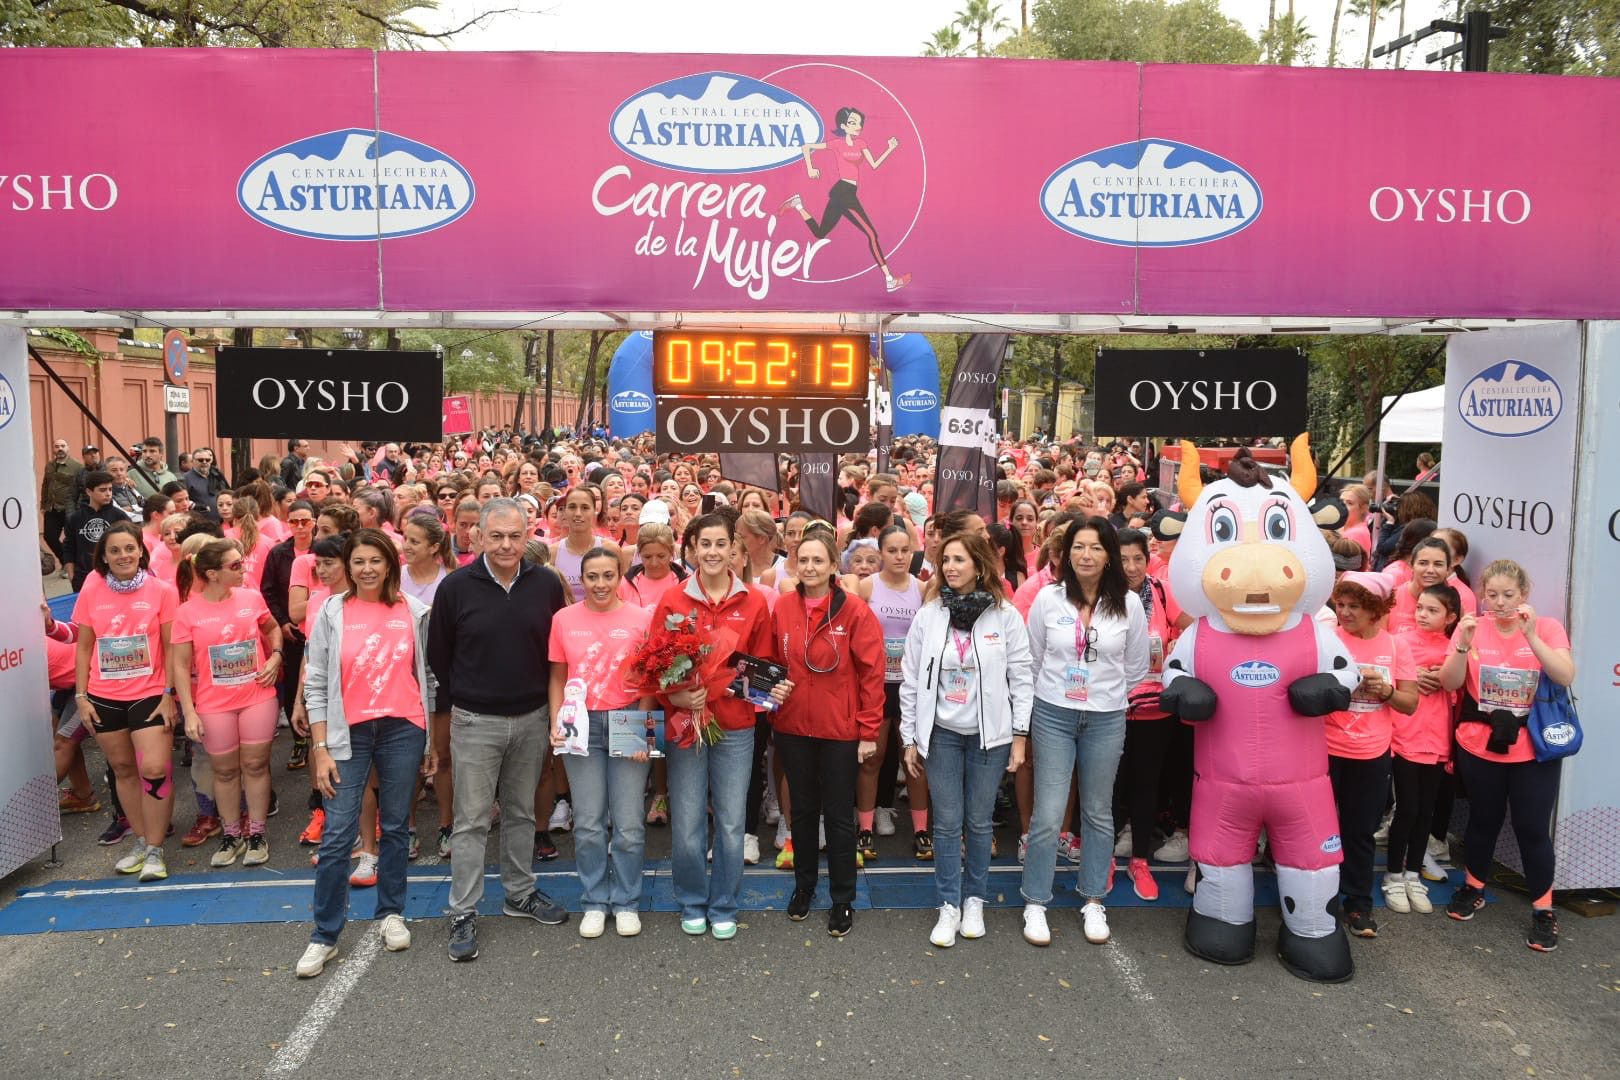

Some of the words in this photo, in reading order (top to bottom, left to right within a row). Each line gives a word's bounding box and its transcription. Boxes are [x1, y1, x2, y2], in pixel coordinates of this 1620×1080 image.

[626, 108, 806, 148] ASTURIANA
[659, 107, 727, 117] CENTRAL
[734, 107, 801, 118] LECHERA
[256, 170, 457, 212] ASTURIANA
[291, 167, 365, 178] CENTRAL
[372, 167, 449, 178] LECHERA
[1092, 176, 1163, 187] CENTRAL
[1169, 177, 1240, 188] LECHERA
[0, 173, 118, 211] SHO
[592, 165, 766, 219] Carrera
[1057, 178, 1246, 219] ASTURIANA
[1369, 186, 1532, 225] OYSHO
[635, 220, 667, 256] de
[675, 216, 698, 257] la
[693, 215, 832, 300] Mujer
[667, 339, 854, 386] 09:52:13
[252, 377, 410, 414] OYSHO
[614, 399, 650, 408] ASTURIANA
[1129, 380, 1278, 412] OYSHO
[1465, 389, 1554, 416] ASTURIANA
[666, 406, 860, 446] OYSHO
[1453, 492, 1554, 536] OYSHO
[880, 606, 918, 616] OYSHO
[1234, 671, 1277, 681] ASTURIANA
